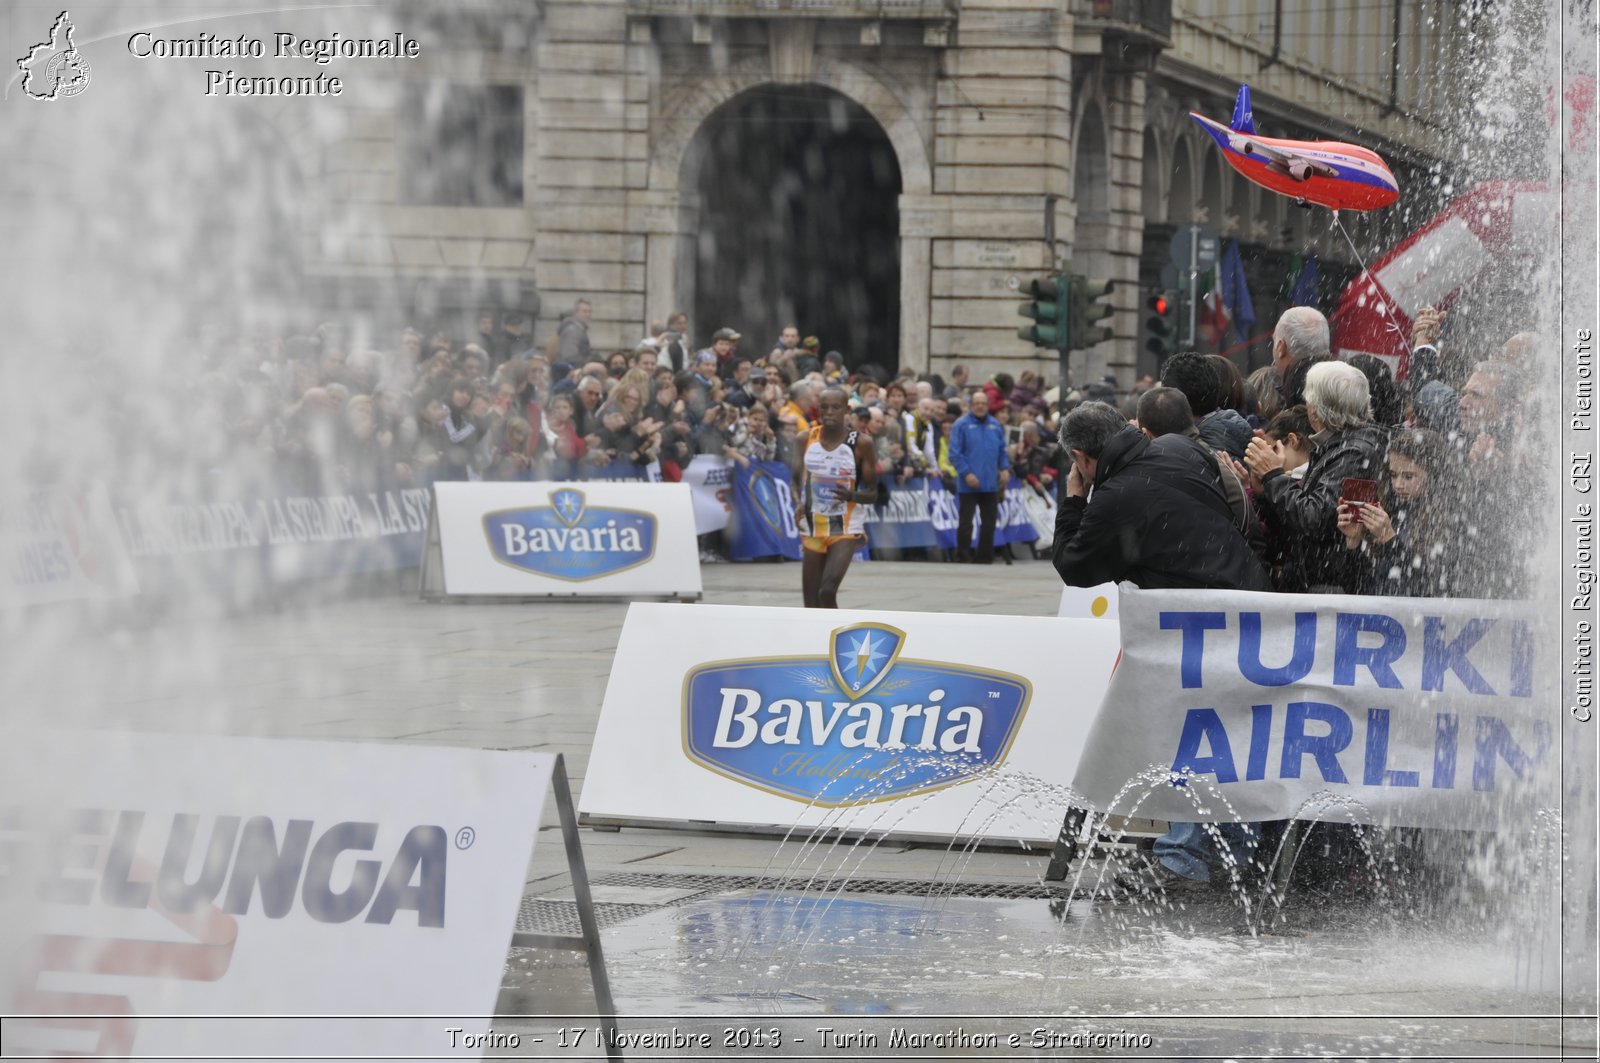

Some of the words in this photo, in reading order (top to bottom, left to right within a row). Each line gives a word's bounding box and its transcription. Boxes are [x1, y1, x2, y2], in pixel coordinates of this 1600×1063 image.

[258, 498, 293, 545] LA
[286, 495, 363, 542] STAMPA
[368, 490, 407, 536] LA
[501, 519, 643, 556] Bavaria
[1159, 611, 1535, 699] TURKI
[712, 688, 983, 754] Bavaria
